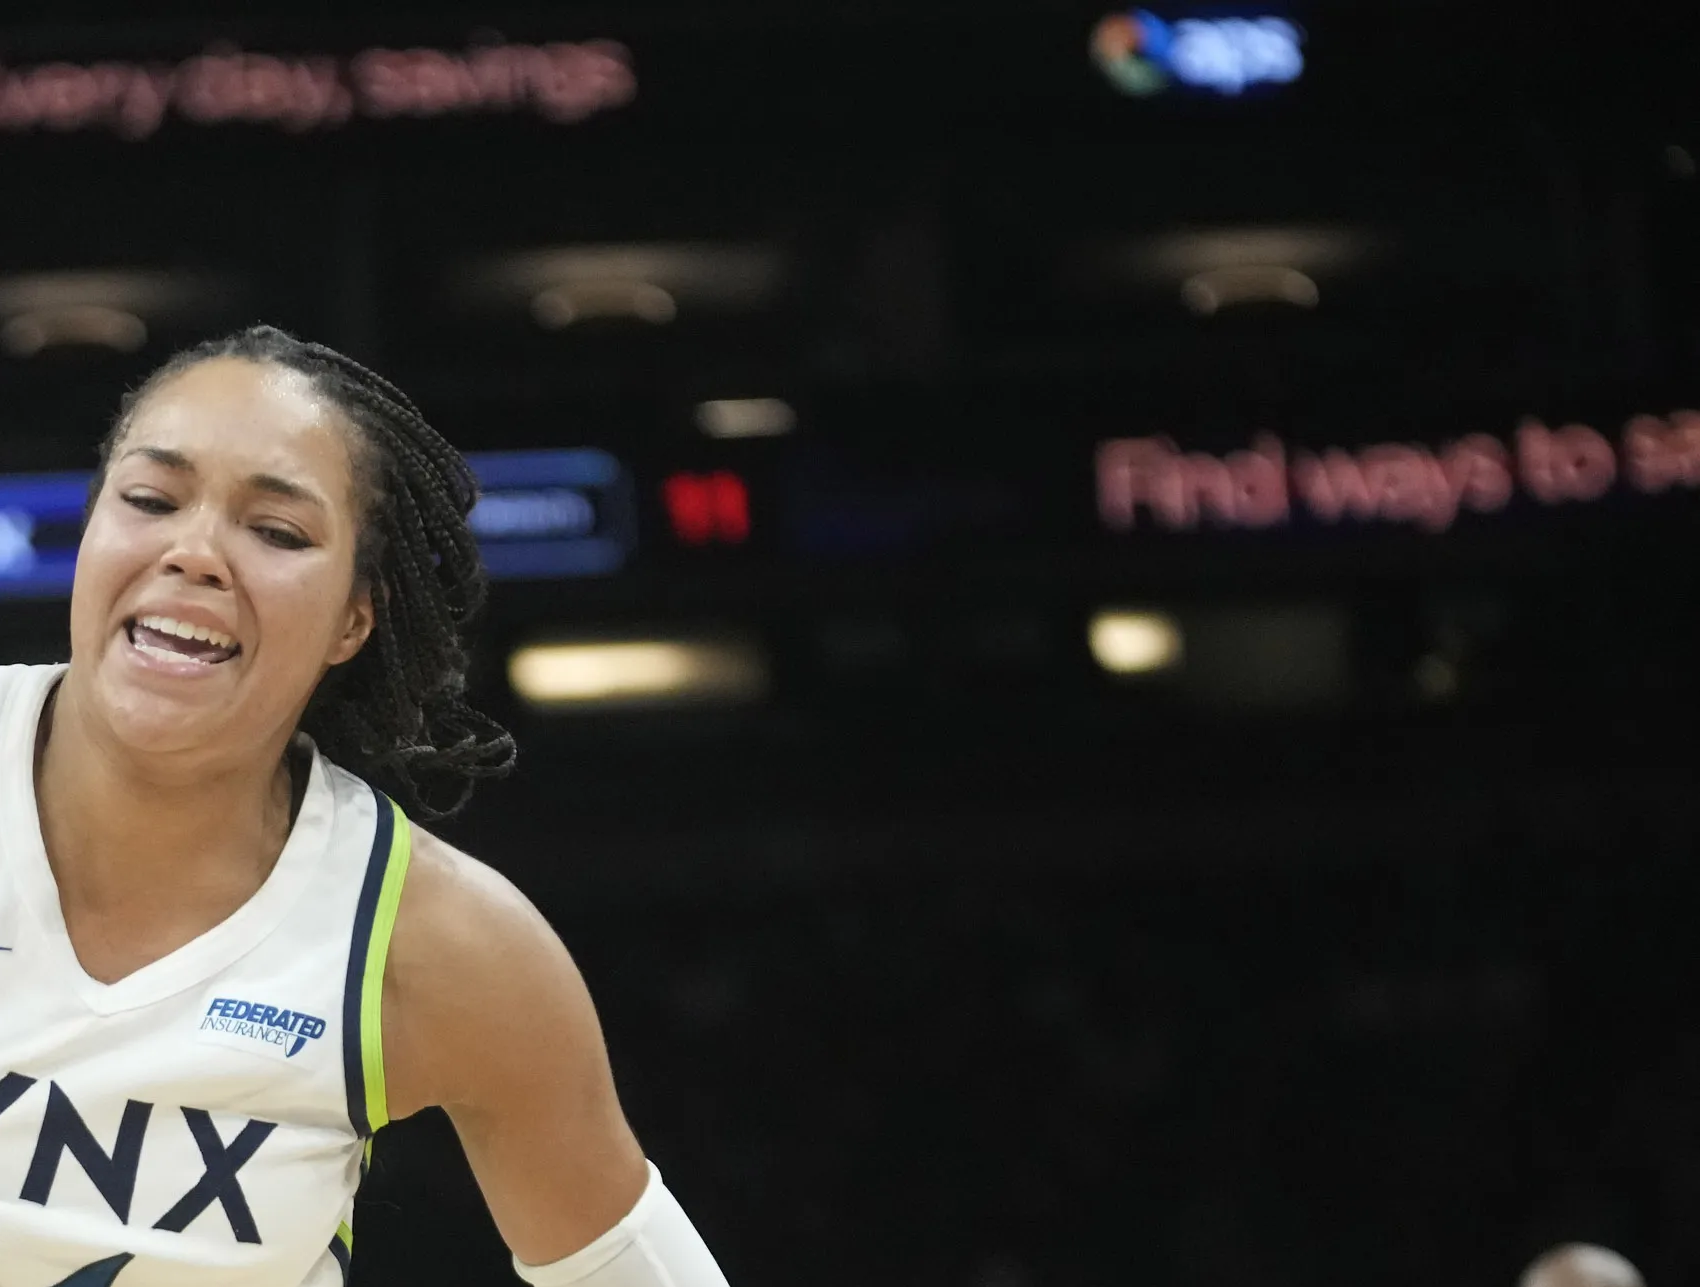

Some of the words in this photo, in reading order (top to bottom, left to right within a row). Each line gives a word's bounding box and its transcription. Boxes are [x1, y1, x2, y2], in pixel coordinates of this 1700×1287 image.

[352, 34, 638, 122] savings
[1096, 434, 1290, 530] Find
[1292, 434, 1512, 533] ways
[1516, 416, 1616, 503] to
[199, 1016, 288, 1046] INSURANCE
[206, 997, 327, 1041] FEDERATED
